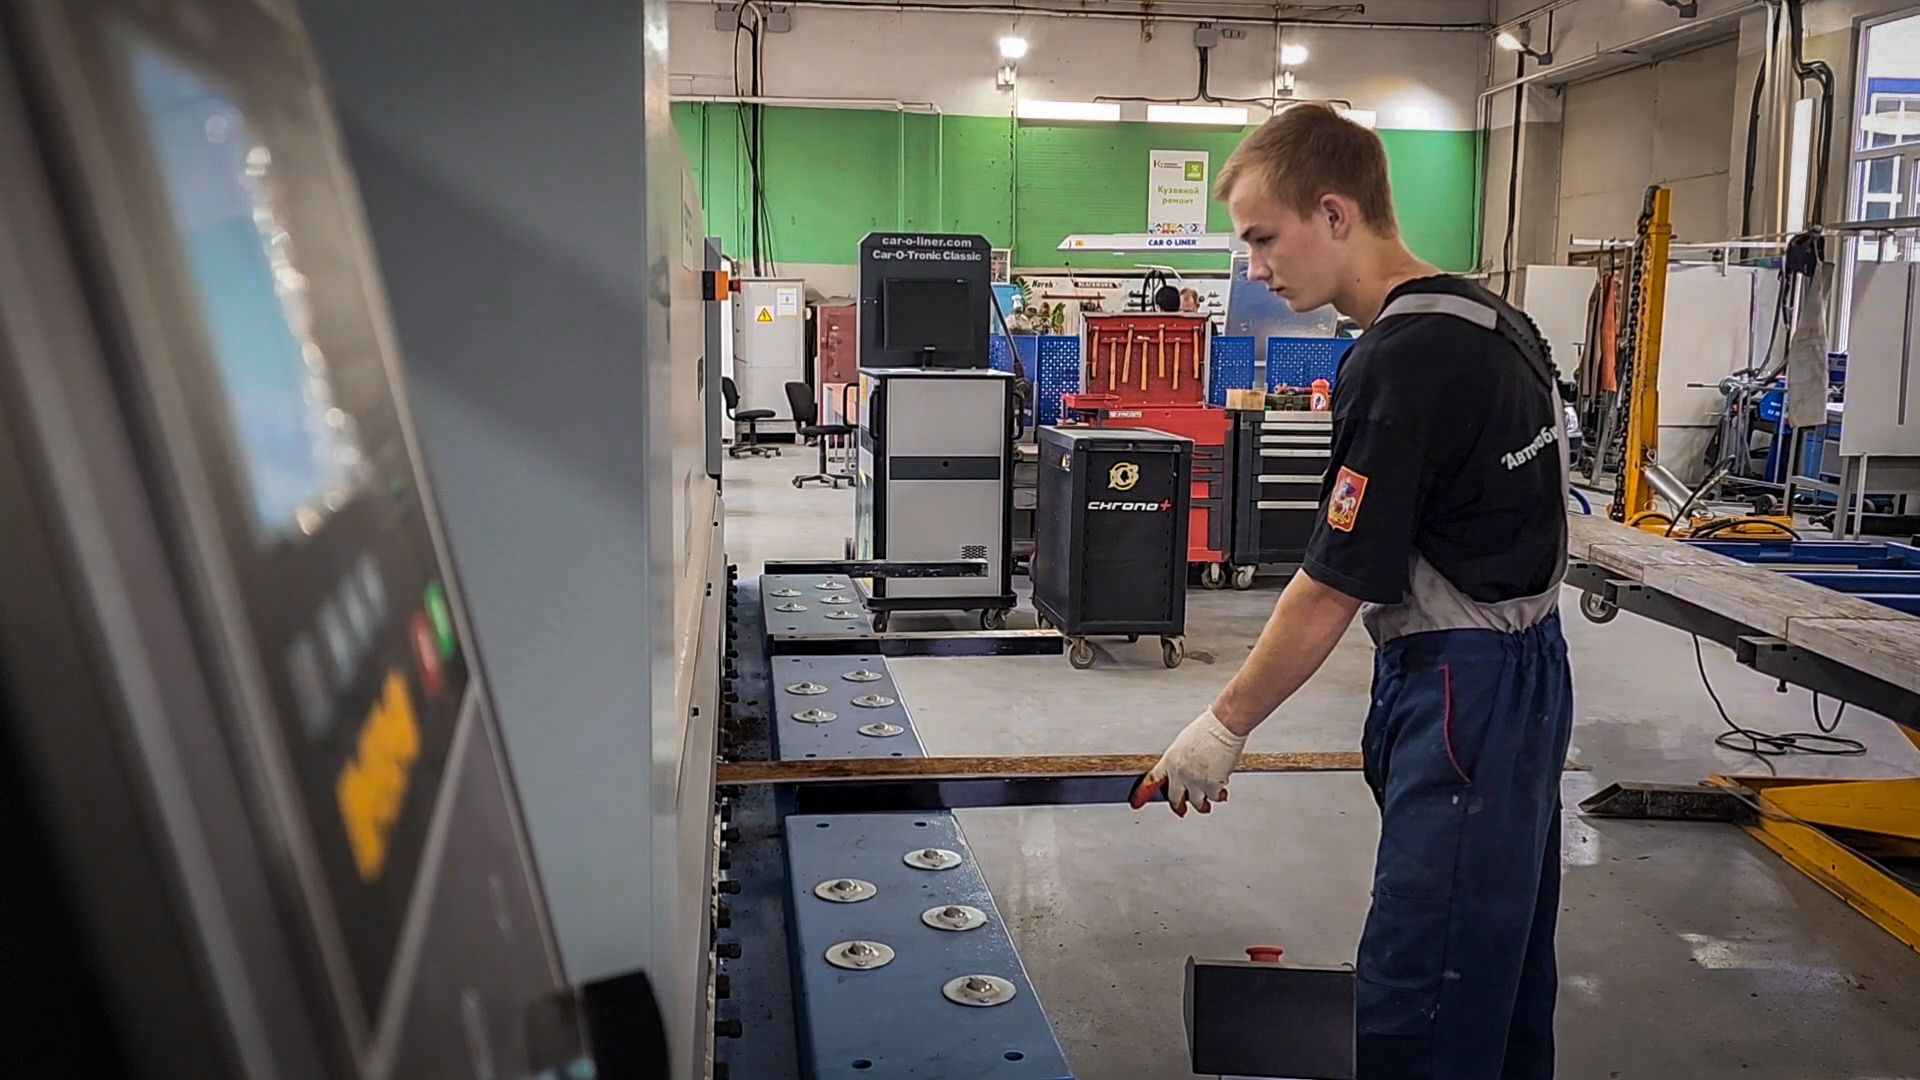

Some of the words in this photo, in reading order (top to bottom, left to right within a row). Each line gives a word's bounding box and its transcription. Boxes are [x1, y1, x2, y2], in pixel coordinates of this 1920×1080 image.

[1157, 185, 1200, 195] Кузовной
[882, 236, 972, 248] car-o-liner.com
[873, 250, 942, 260] Car-O-Tronic
[943, 251, 982, 261] Classic
